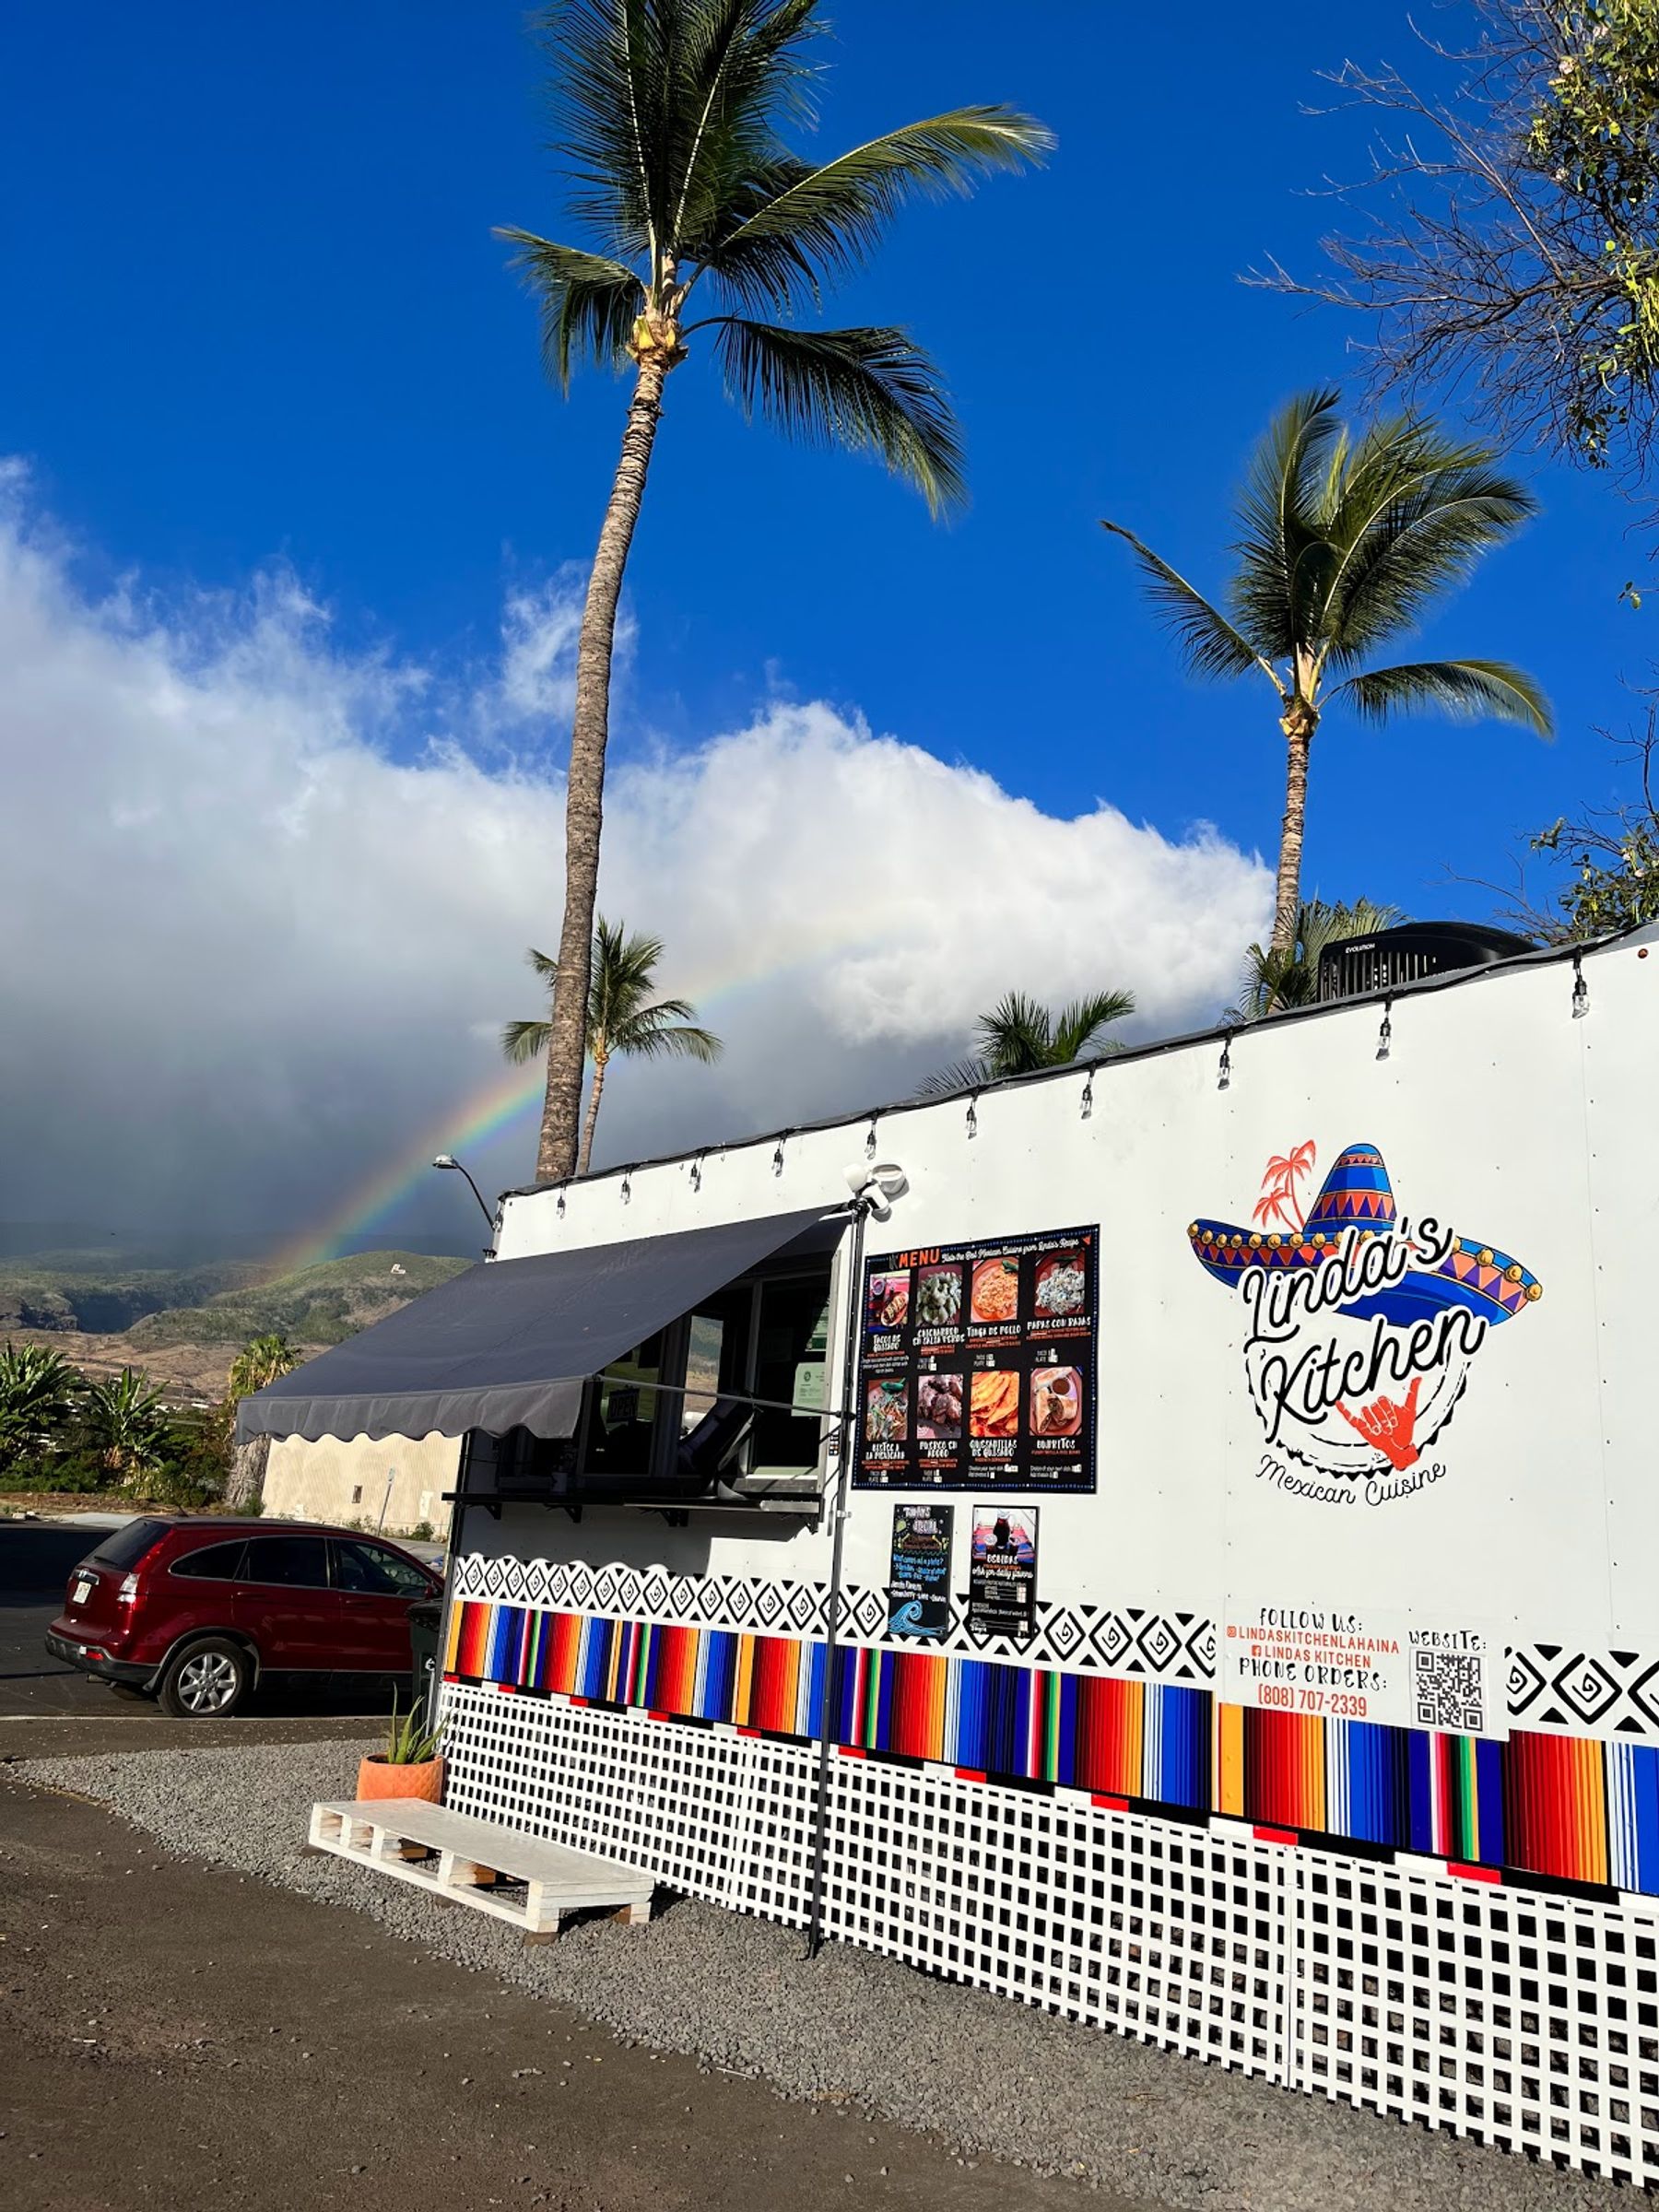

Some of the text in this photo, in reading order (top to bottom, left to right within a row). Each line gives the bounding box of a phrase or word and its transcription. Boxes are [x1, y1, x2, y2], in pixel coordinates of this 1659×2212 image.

[1346, 943, 1375, 953] EVOLUTION
[899, 1248, 940, 1268] MENU
[1243, 1216, 1454, 1354] Linda's
[1027, 1320, 1051, 1331] PAPAS
[1261, 1310, 1487, 1444] Kitchen
[1255, 1453, 1447, 1507] Mexican Cuisine
[1260, 1607, 1362, 1634] FOLLOW US:
[1239, 1626, 1400, 1654] LINDASKITCHENLAHAINA
[1408, 1630, 1487, 1652] WEBSITE:
[1265, 1644, 1371, 1668] LINDAS KITCHEN
[1240, 1657, 1387, 1692] PHONE ORDERS:
[1258, 1683, 1368, 1717] (808) 707-2339
